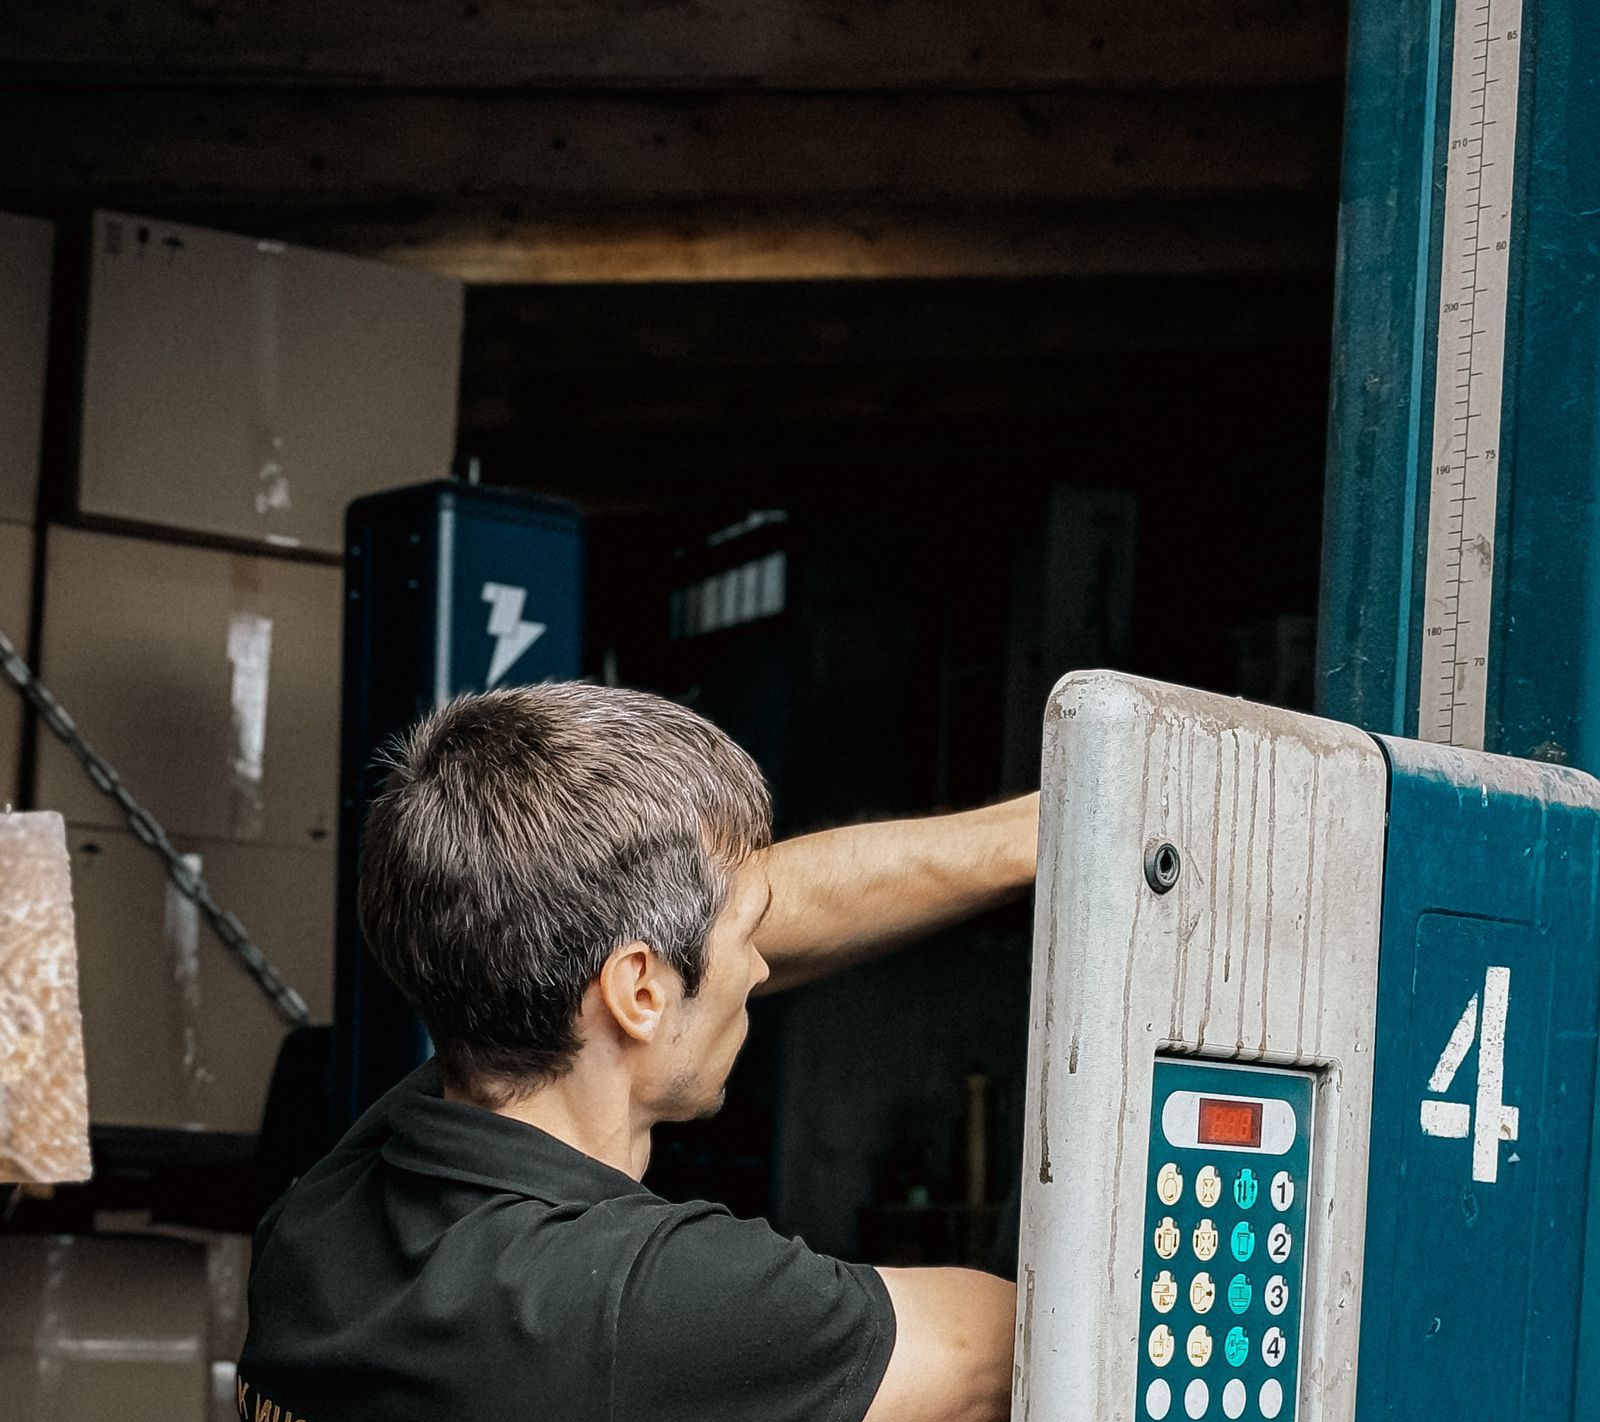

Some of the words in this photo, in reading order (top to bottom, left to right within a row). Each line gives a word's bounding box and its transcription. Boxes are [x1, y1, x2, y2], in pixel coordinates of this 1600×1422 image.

[1452, 138, 1467, 150] 210
[1443, 302, 1459, 313] 200
[1485, 449, 1496, 460] 75
[1436, 465, 1450, 476] 190
[1427, 626, 1442, 637] 180
[1474, 657, 1485, 667] 70
[1420, 966, 1520, 1184] 4
[1275, 1181, 1287, 1204] 1
[1272, 1234, 1287, 1257] 2
[1270, 1285, 1284, 1308] 3
[1266, 1337, 1280, 1360] 4
